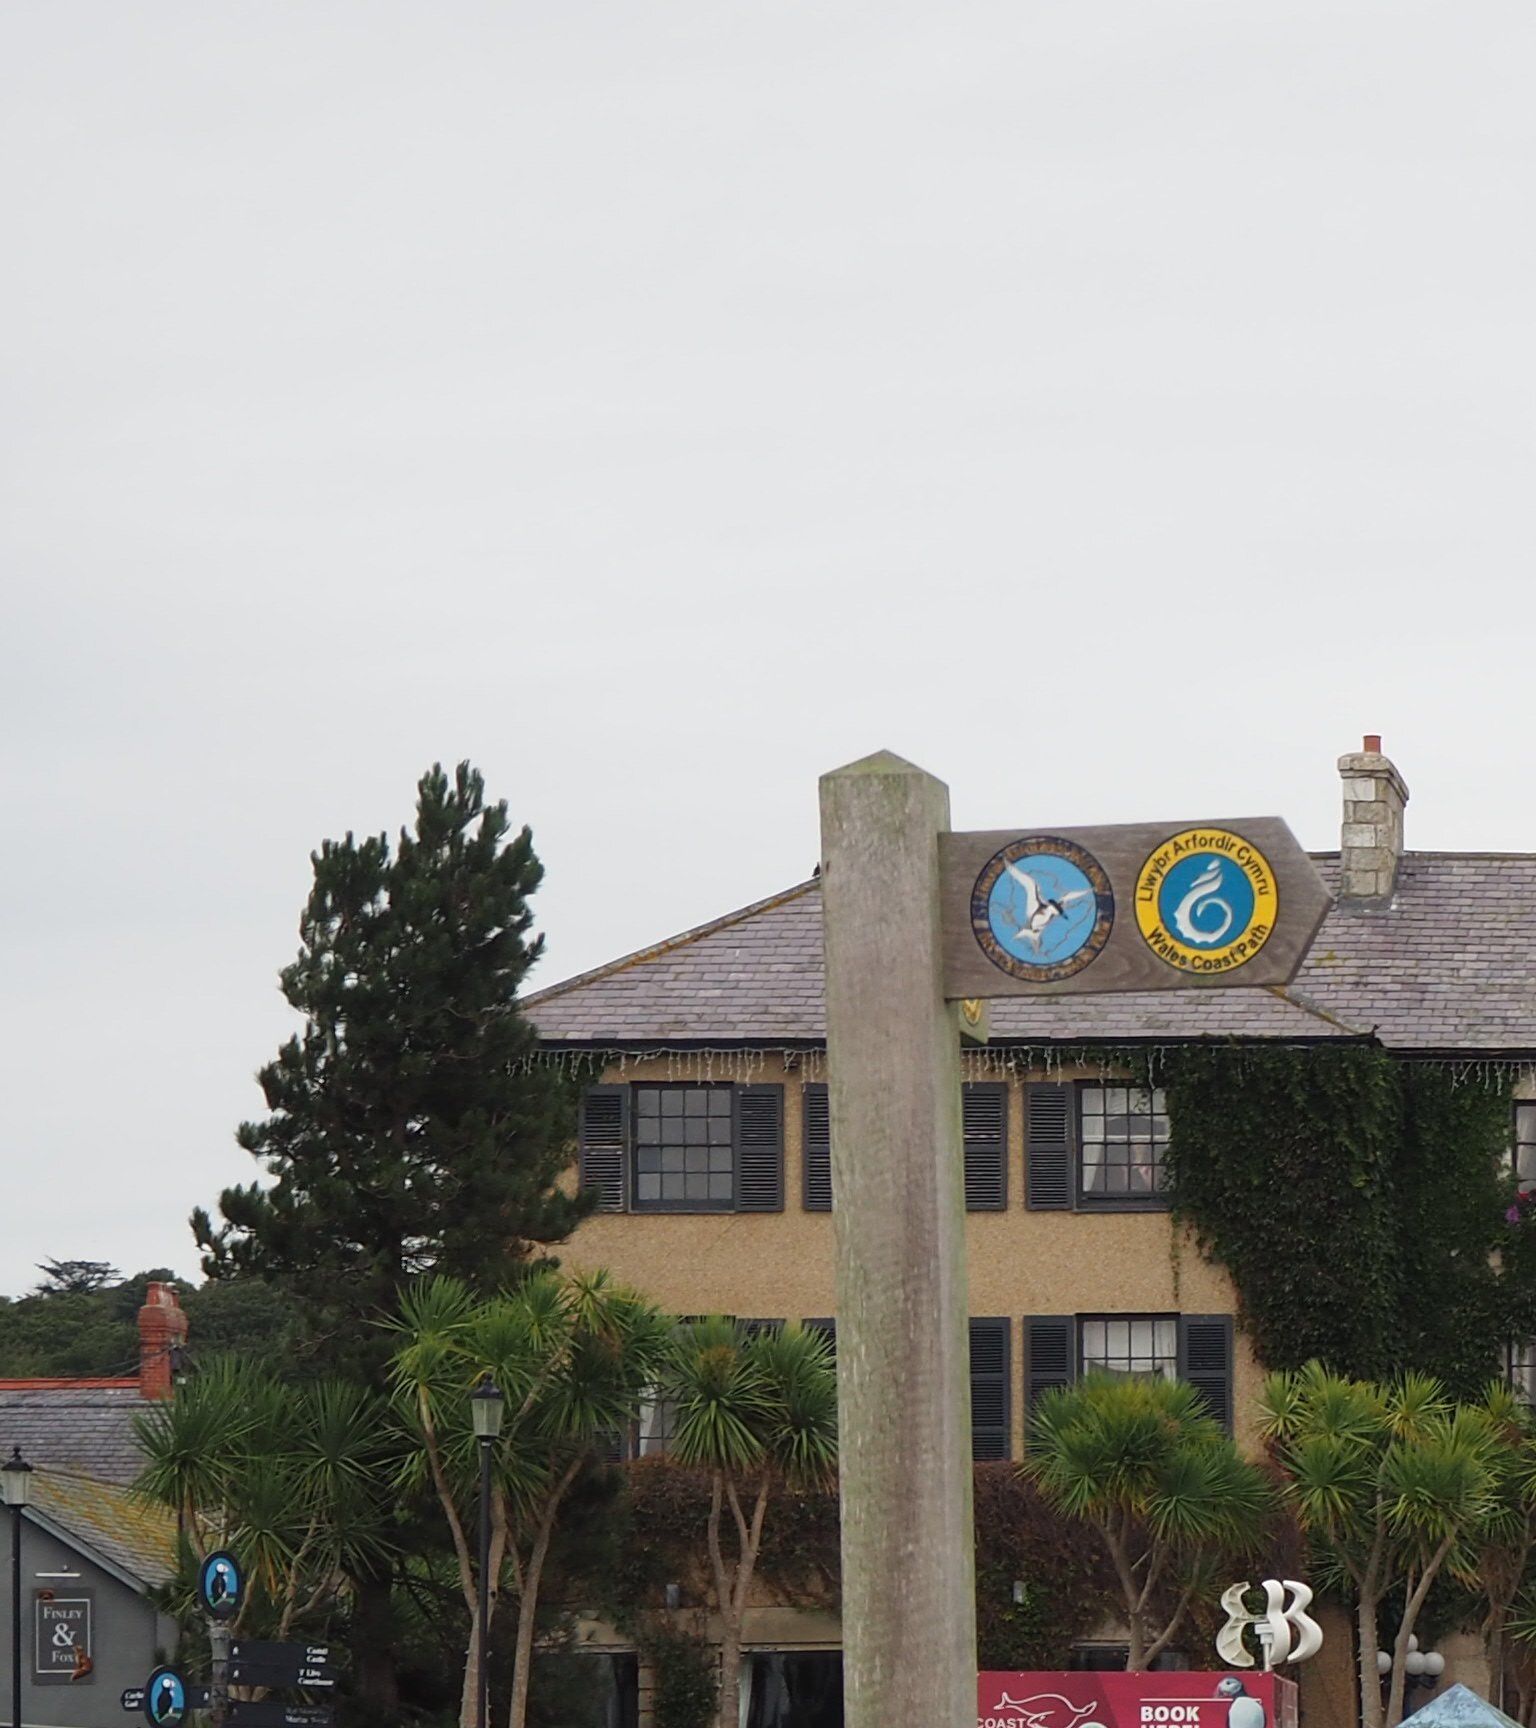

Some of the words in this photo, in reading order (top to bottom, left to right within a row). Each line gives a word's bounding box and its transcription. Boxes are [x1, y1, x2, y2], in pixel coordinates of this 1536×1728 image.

[1138, 851, 1172, 902] Llwybr
[1172, 834, 1236, 856] Arfordir
[1236, 846, 1269, 896] Cymru
[1147, 928, 1187, 966] Wales
[1191, 952, 1239, 970] Coast
[1237, 924, 1268, 957] Path
[43, 1606, 83, 1619] FINLEY
[52, 1622, 77, 1647] &
[1140, 1706, 1200, 1722] BOOK
